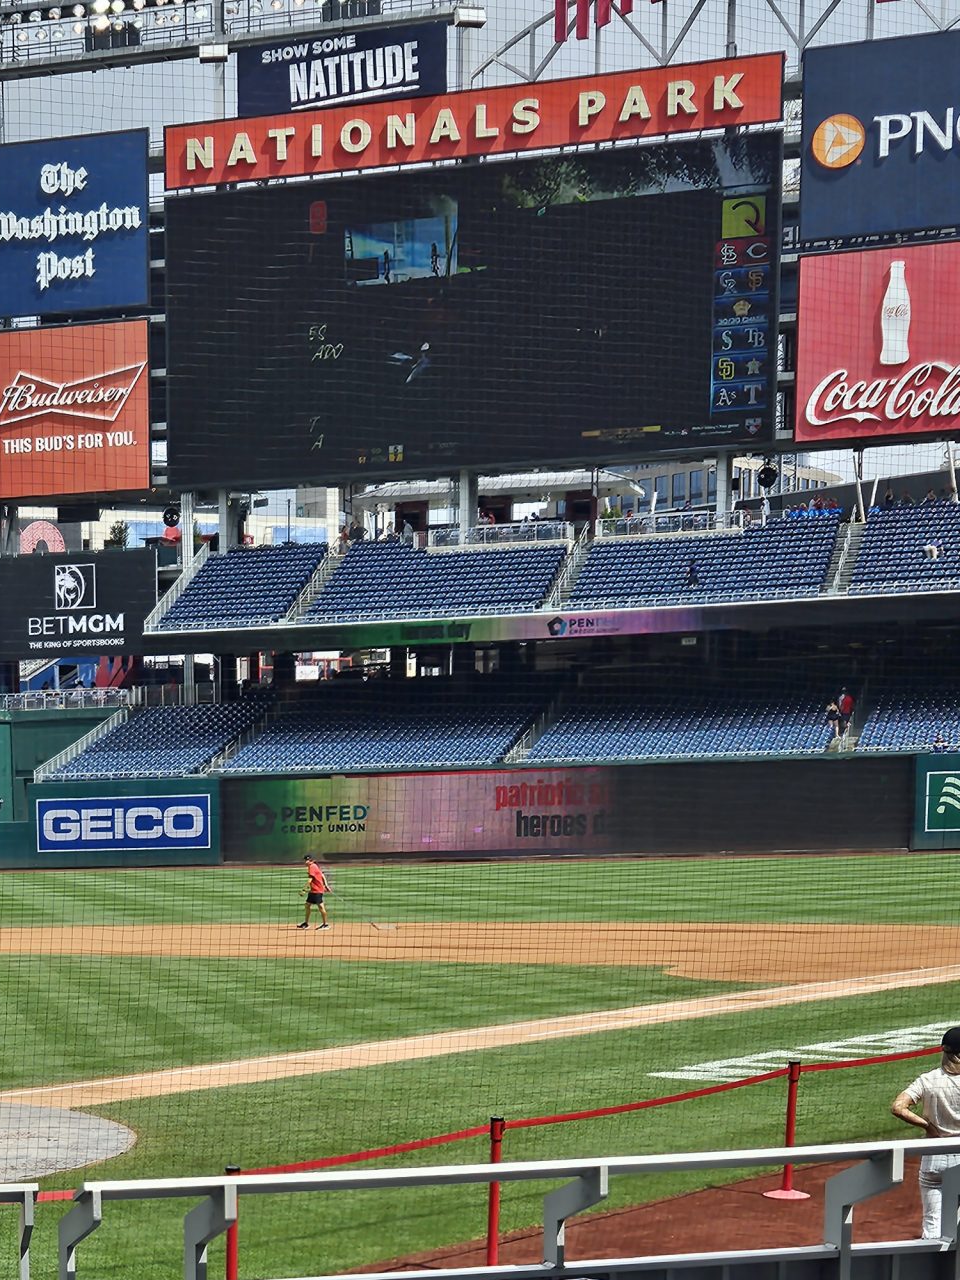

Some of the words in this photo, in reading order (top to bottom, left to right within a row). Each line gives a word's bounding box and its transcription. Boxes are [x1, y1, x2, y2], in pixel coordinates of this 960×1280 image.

[261, 43, 309, 64] SHOW
[312, 34, 356, 55] SOME
[289, 40, 420, 103] NATITUDE
[186, 97, 541, 171] NATIONALS
[578, 73, 745, 128] PARK
[873, 107, 960, 159] PN
[40, 161, 89, 197] The
[36, 247, 96, 291] Post
[2, 382, 130, 412] Budweiser
[806, 361, 960, 427] Coca-Cola
[2, 439, 32, 454] THIS
[35, 434, 74, 452] BUD'S
[77, 433, 103, 449] FOR
[105, 431, 137, 447] YOU.
[28, 612, 125, 636] BETMGM
[44, 641, 61, 649] KING
[62, 640, 72, 648] OF
[73, 638, 125, 647] SPORTSBOOKS
[42, 805, 204, 842] GEICO
[281, 805, 366, 822] PENFED
[281, 824, 323, 834] CREDIT
[328, 823, 366, 833] UNION
[516, 810, 587, 837] heroes
